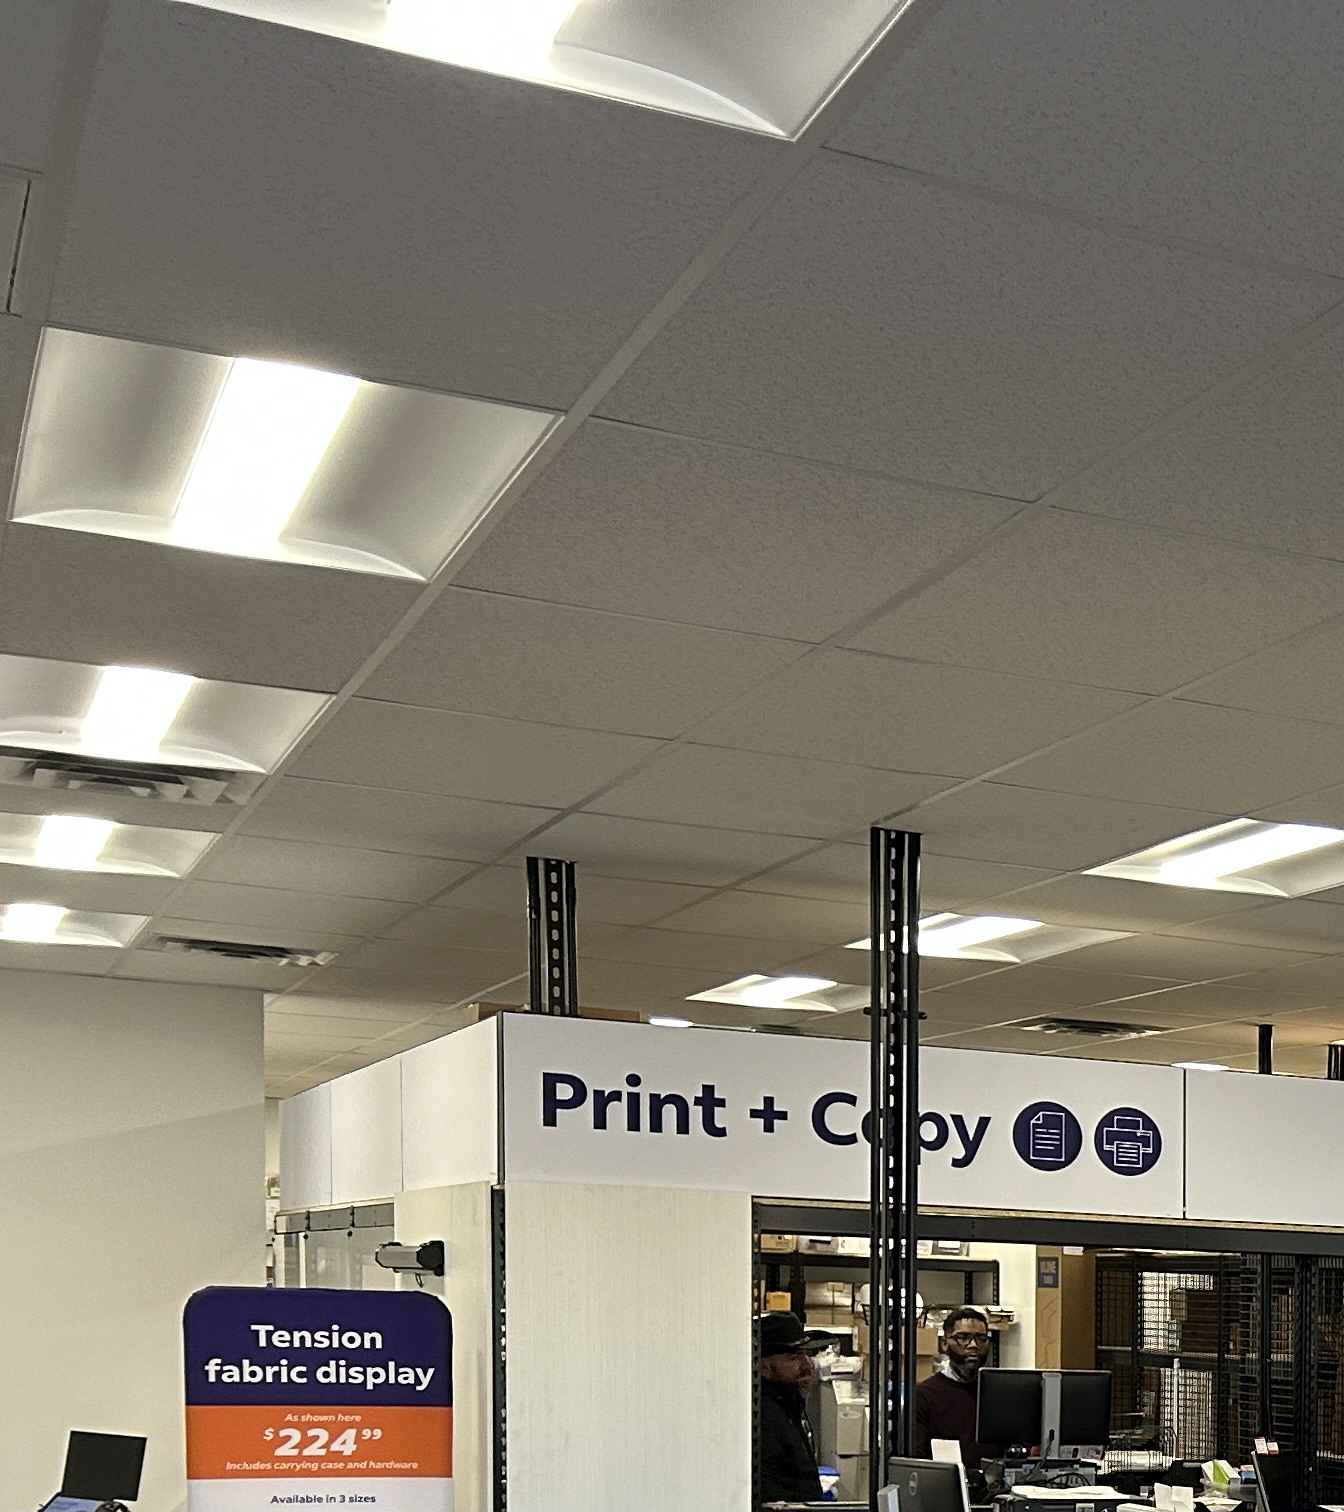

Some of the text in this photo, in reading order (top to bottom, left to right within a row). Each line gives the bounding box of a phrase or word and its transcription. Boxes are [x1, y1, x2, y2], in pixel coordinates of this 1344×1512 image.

[541, 1071, 727, 1138] Print
[749, 1095, 789, 1134] +
[250, 1324, 383, 1349] Tension
[204, 1358, 436, 1391] fabric display
[284, 1413, 362, 1422] As shown here
[226, 1461, 419, 1472] Includes carrying case and hardware
[270, 1494, 376, 1504] Available in 3 sizes
